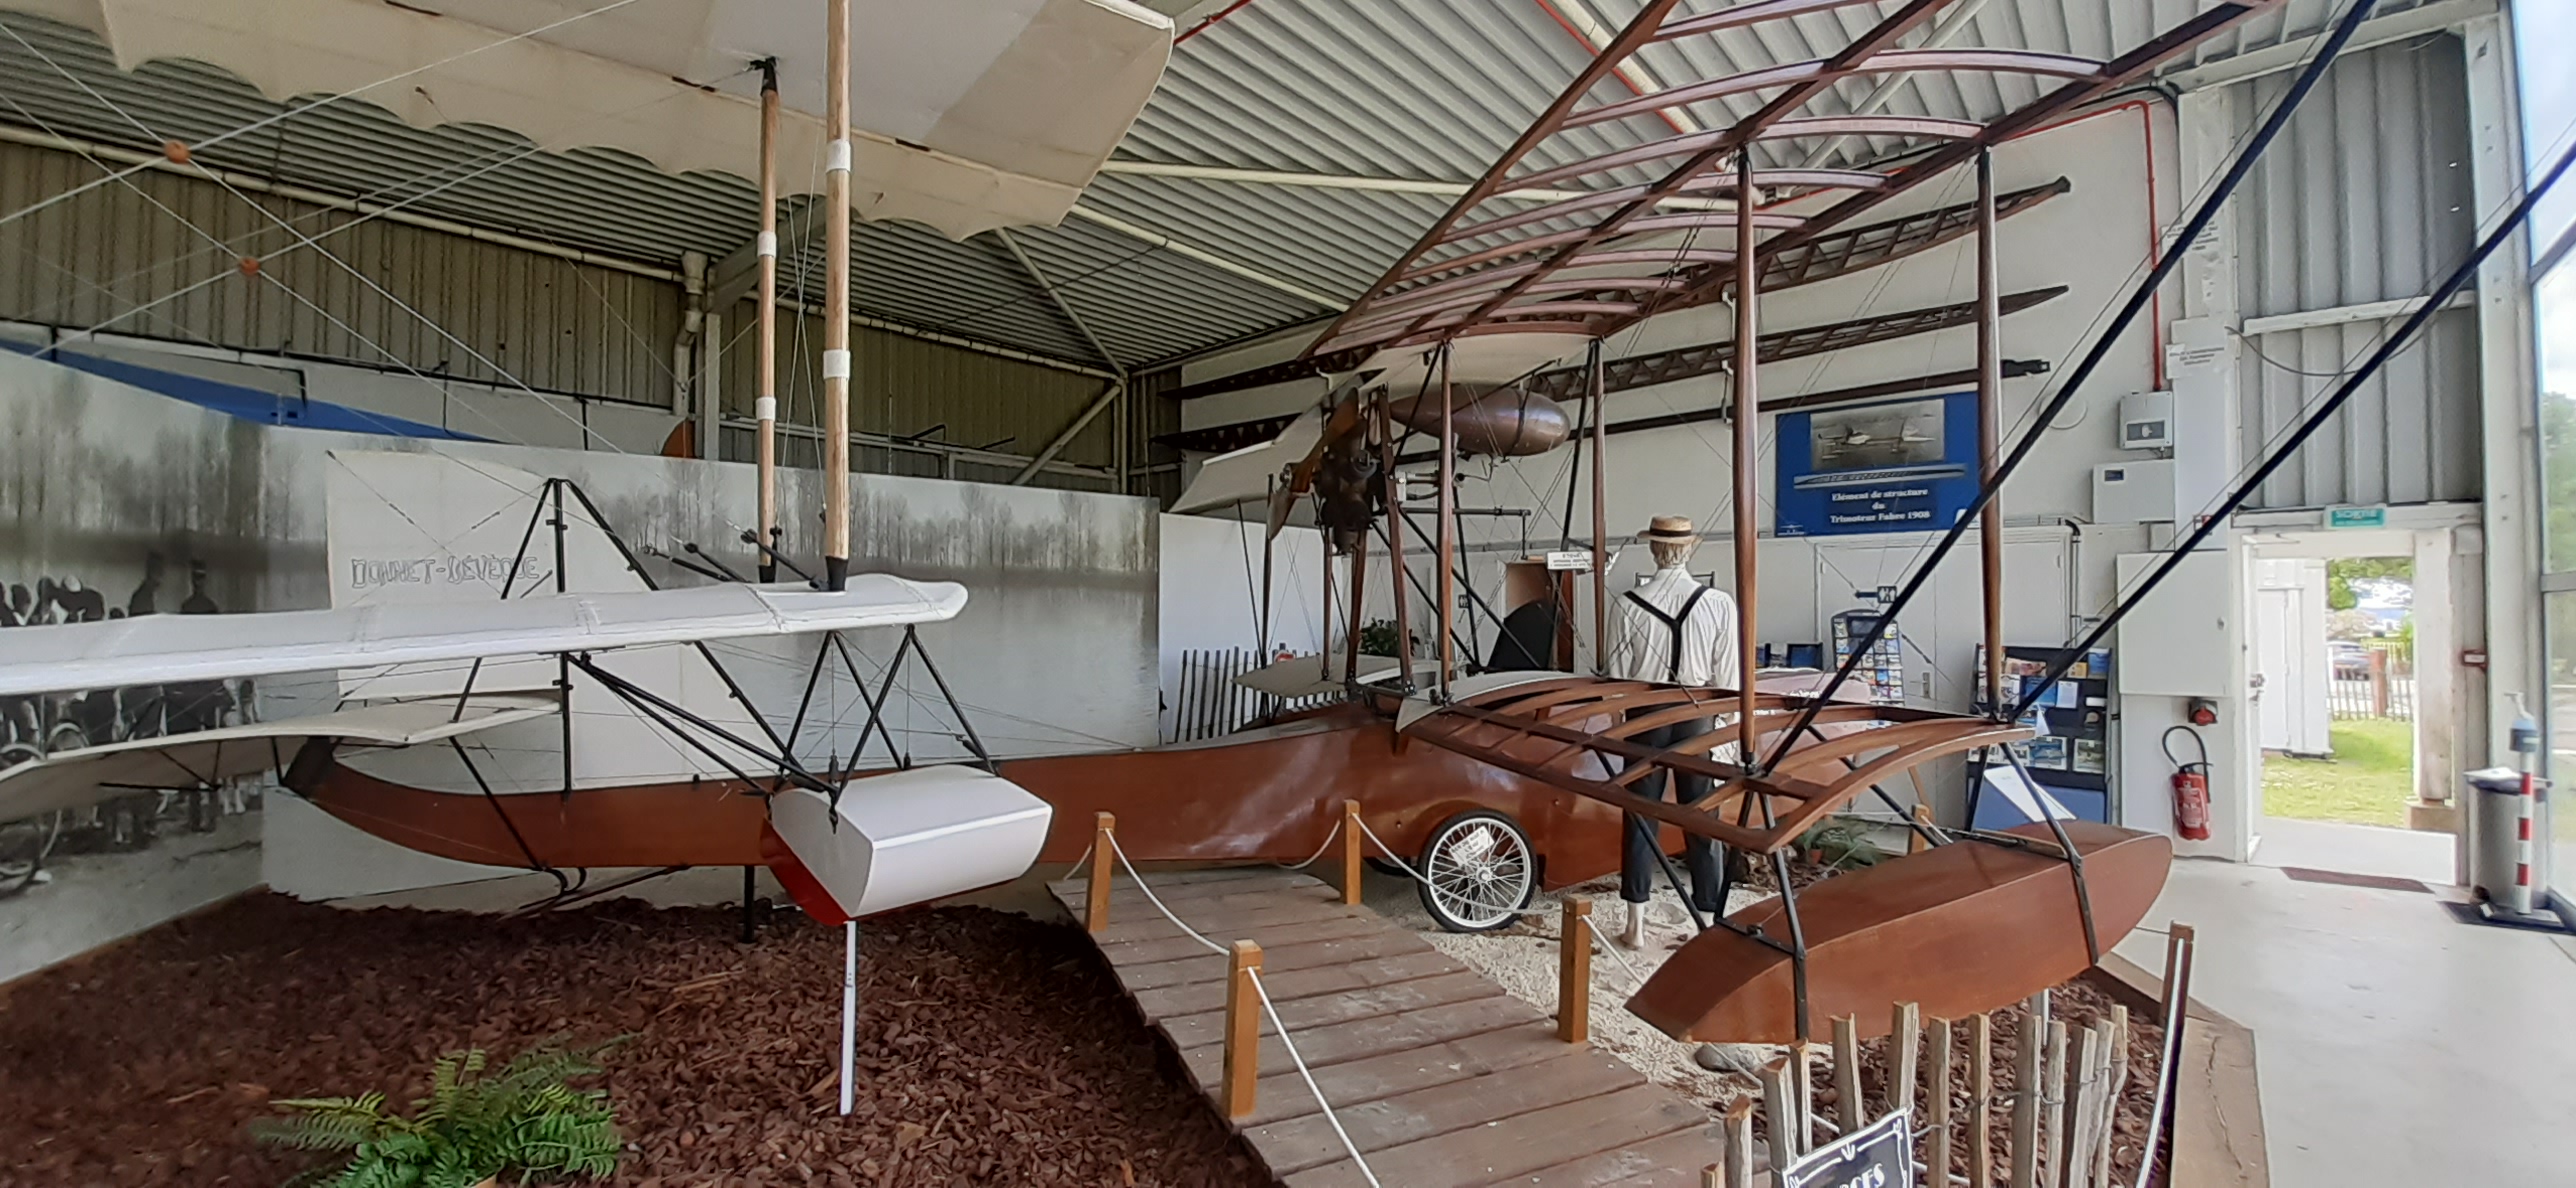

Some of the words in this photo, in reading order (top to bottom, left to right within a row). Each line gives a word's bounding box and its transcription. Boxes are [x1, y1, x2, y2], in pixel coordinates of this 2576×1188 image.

[1870, 491, 1882, 499] de
[1883, 489, 1928, 498] structure
[1872, 502, 1886, 510] du
[1830, 515, 1876, 523] Trimoteur
[1879, 512, 1906, 521] Fabre
[1908, 511, 1931, 520] 1908
